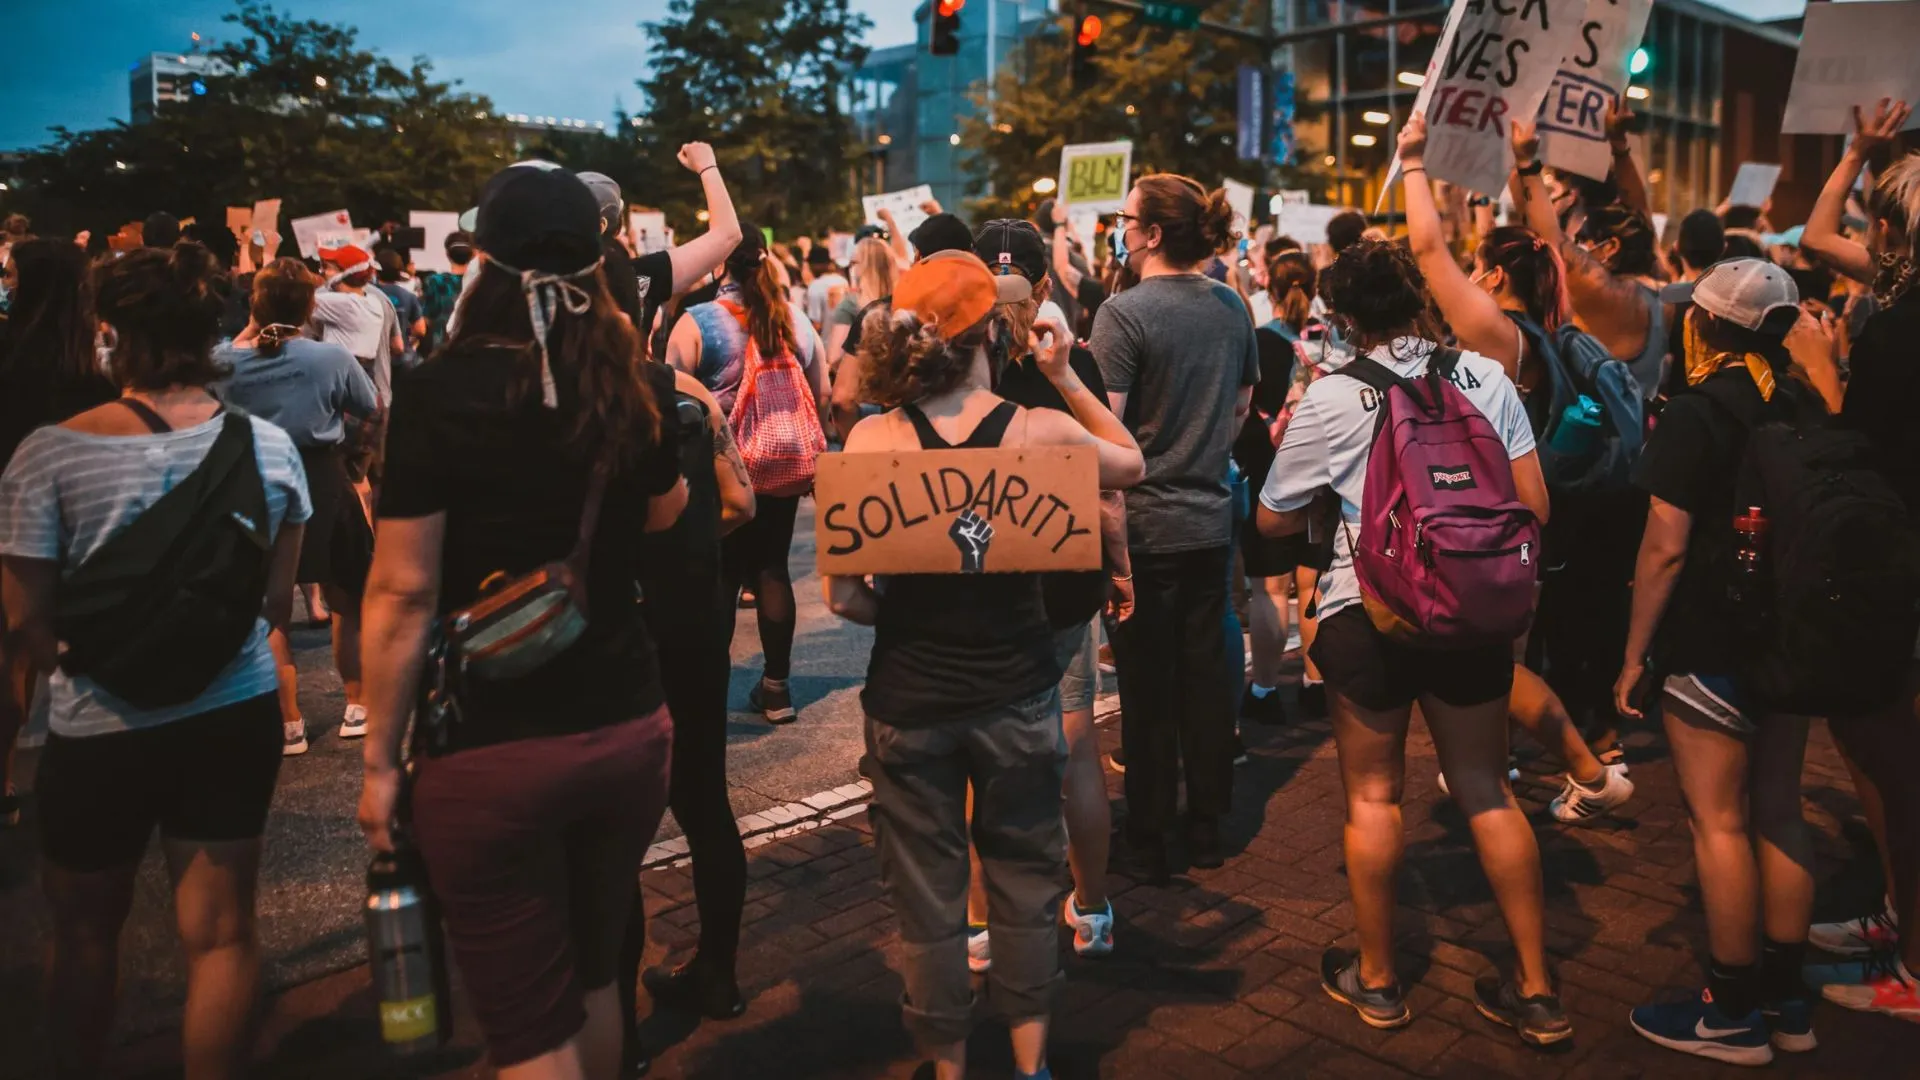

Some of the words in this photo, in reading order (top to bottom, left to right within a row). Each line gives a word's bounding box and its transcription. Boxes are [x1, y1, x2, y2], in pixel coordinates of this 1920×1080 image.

[1443, 28, 1530, 88] VES
[1432, 86, 1509, 138] TER
[1537, 79, 1604, 132] TER
[1069, 156, 1124, 199] BLM
[824, 467, 1091, 555] SOLIDARITY
